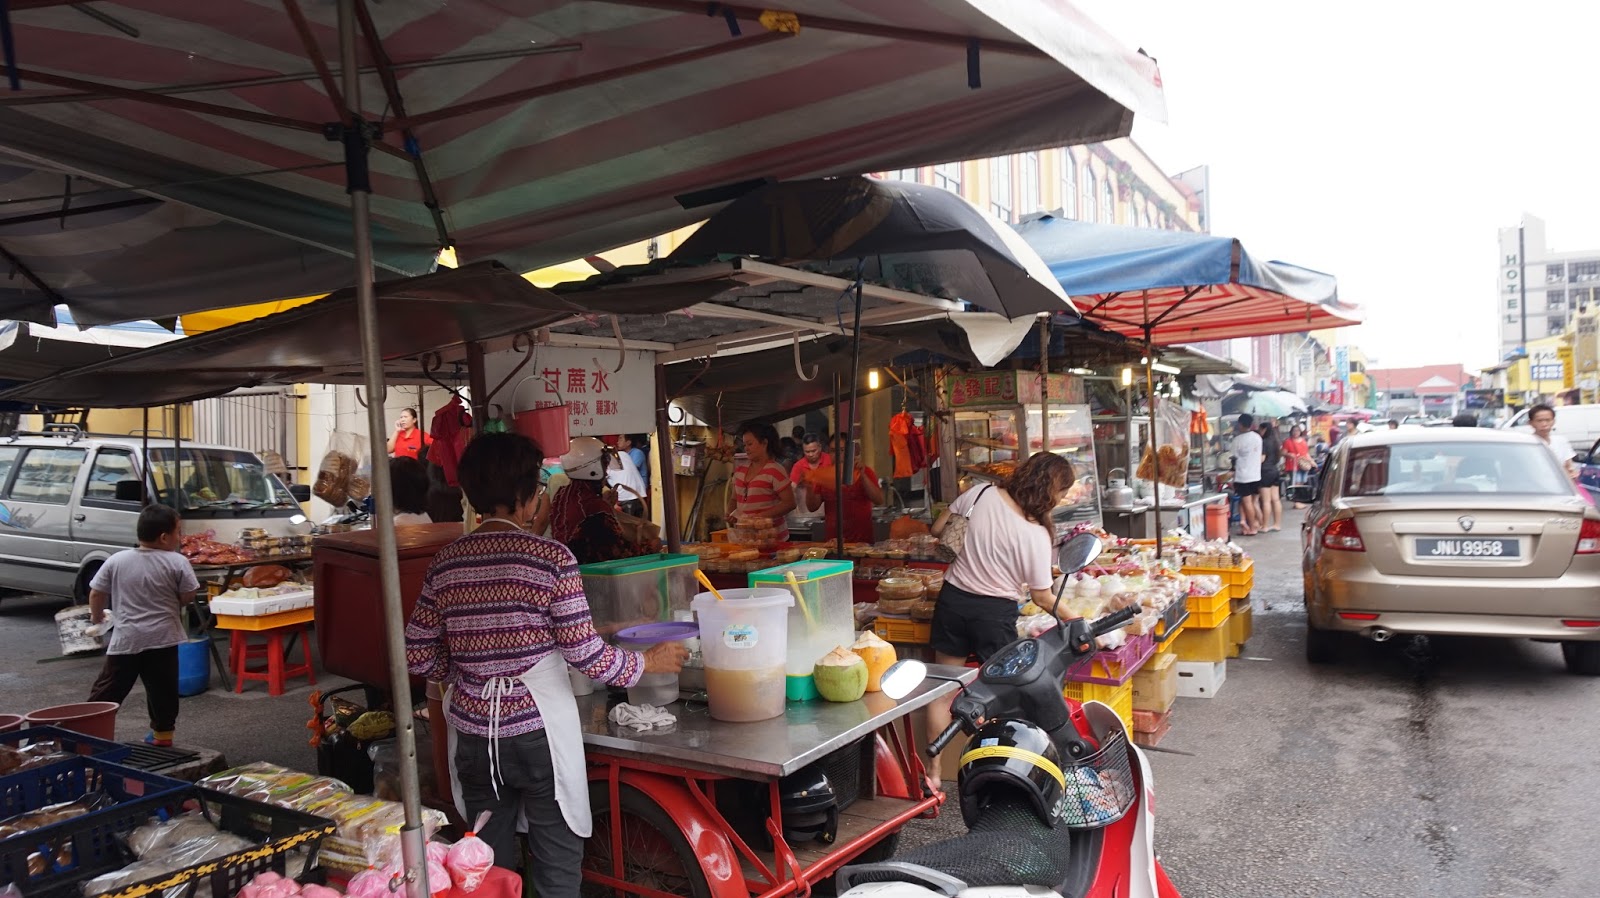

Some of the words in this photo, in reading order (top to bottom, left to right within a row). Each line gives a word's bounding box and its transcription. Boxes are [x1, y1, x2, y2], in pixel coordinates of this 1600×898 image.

[1506, 254, 1518, 323] HOTEL
[542, 368, 609, 393] 甘蔗水
[1431, 540, 1461, 555] JNU
[1462, 540, 1503, 556] 9958
